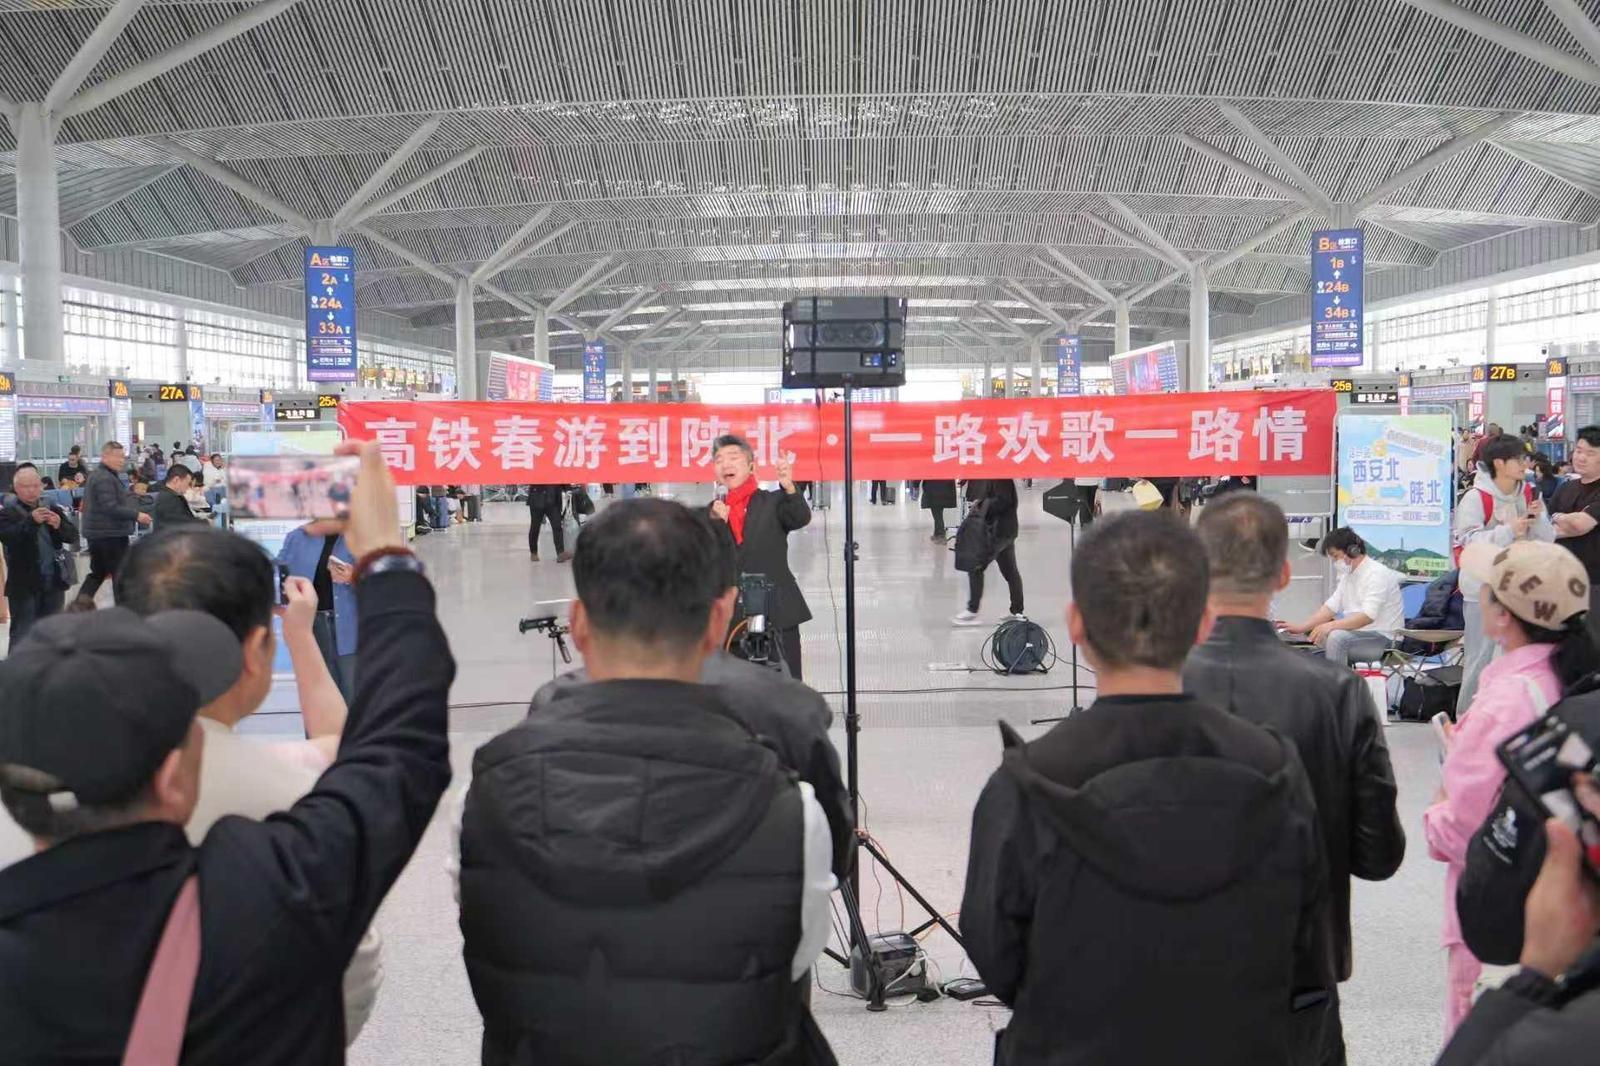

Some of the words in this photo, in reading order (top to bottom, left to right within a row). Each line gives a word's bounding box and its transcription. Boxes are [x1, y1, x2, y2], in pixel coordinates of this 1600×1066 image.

[322, 273, 337, 285] 2A
[1325, 281, 1349, 293] 24B
[319, 296, 343, 309] 24A
[1325, 307, 1349, 318] 34B
[319, 322, 343, 334] 33A
[1490, 366, 1516, 379] 27B
[1333, 381, 1352, 391] 25B
[160, 386, 185, 400] 27A
[319, 396, 338, 407] 25A
[1353, 457, 1400, 483] 西安北
[1410, 479, 1442, 505] 陕北
